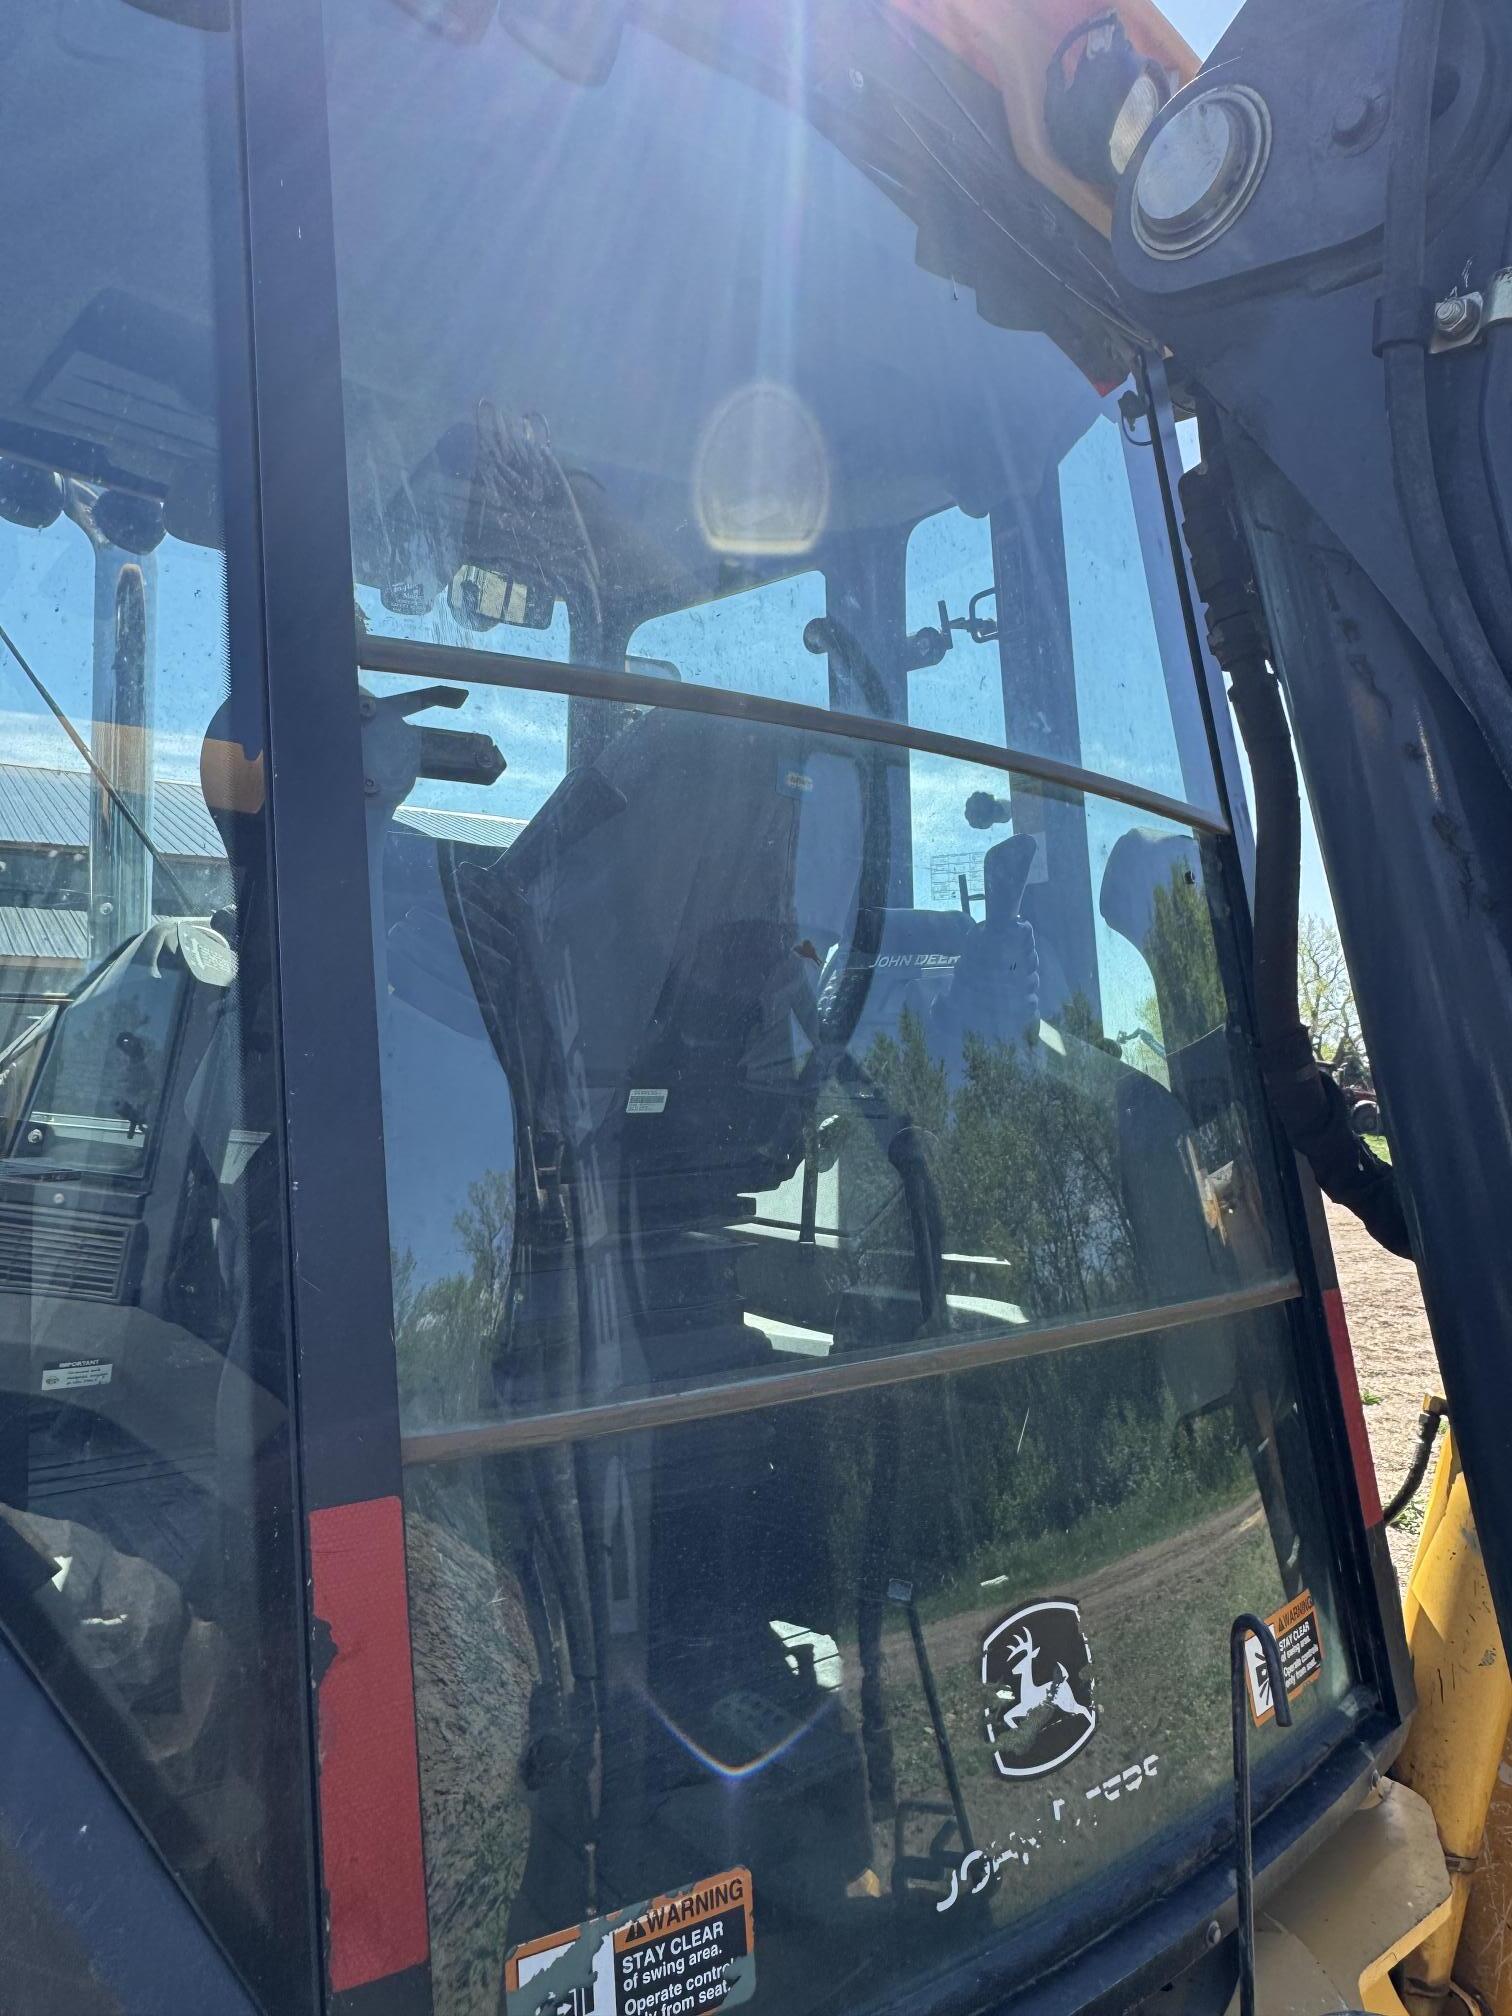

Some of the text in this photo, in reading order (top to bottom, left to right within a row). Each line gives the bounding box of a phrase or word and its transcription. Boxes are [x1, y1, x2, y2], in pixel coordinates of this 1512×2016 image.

[867, 954, 913, 969] JOHN
[1283, 1596, 1313, 1629] WARNING
[1279, 1621, 1310, 1652] STAY CLEAR
[646, 1878, 744, 1933] WARNING
[622, 1921, 724, 1974] STAY CLEAR
[623, 1944, 722, 1992] of swing area.
[624, 1983, 683, 2016] Operate
[661, 1979, 732, 2016] from seat.
